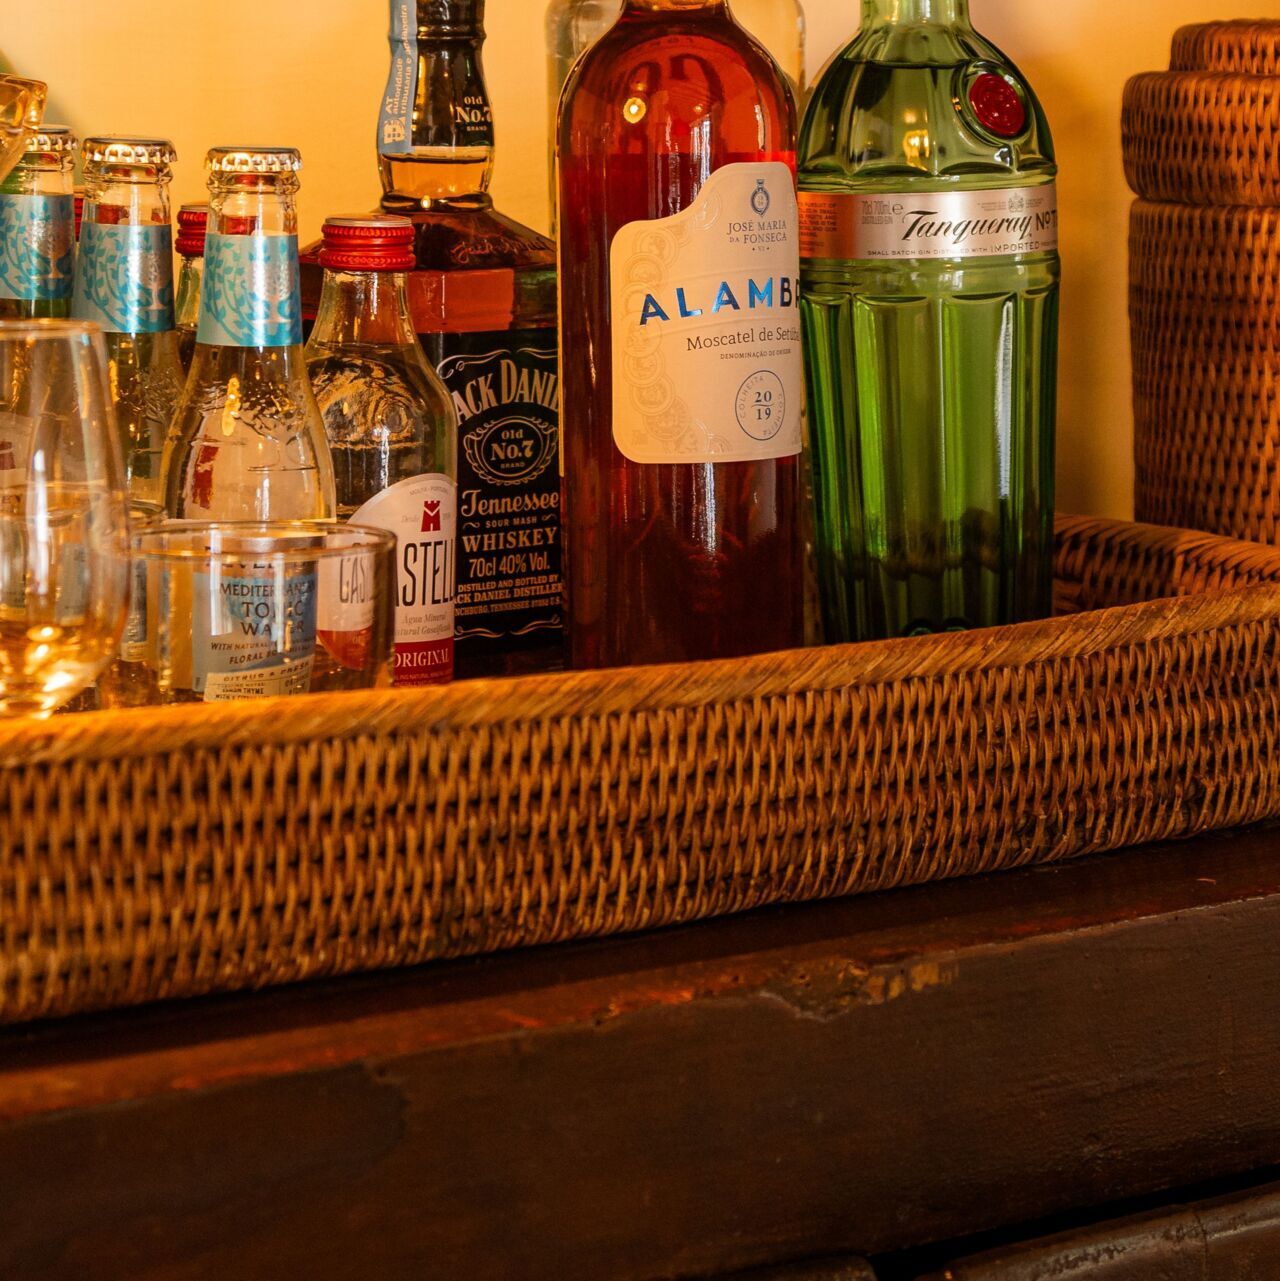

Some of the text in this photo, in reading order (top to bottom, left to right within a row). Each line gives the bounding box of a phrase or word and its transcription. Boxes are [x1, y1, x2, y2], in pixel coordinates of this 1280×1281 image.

[392, 57, 403, 114] autoridade
[385, 95, 393, 114] AT
[464, 96, 483, 106] Old
[727, 219, 787, 235] JOSÉ MARIA
[743, 231, 787, 244] FONSECA
[891, 249, 915, 257] BATCH
[918, 248, 930, 256] GIN
[972, 246, 988, 254] WITH
[991, 240, 1040, 254] IMPORTED
[687, 328, 754, 351] Moscatel
[758, 326, 774, 341] de
[720, 349, 768, 361] DENOMINAÇÃO
[451, 373, 499, 426] ACK
[739, 376, 763, 419] COLHEITA
[754, 390, 772, 403] 20
[757, 407, 771, 421] 19
[501, 429, 523, 439] Old
[490, 440, 534, 460] No.7
[461, 489, 559, 517] Tennessee
[486, 516, 537, 528] SOUR MASH
[462, 526, 558, 553] WHISKEY
[469, 551, 551, 578] 70cl 40% Vol.
[458, 574, 559, 593] DISTILLED AND BOTTLED BY
[455, 582, 563, 604] ACK DANIEL DISTILLER
[211, 642, 269, 651] WITH NATURAL
[229, 652, 264, 665] FLORAL
